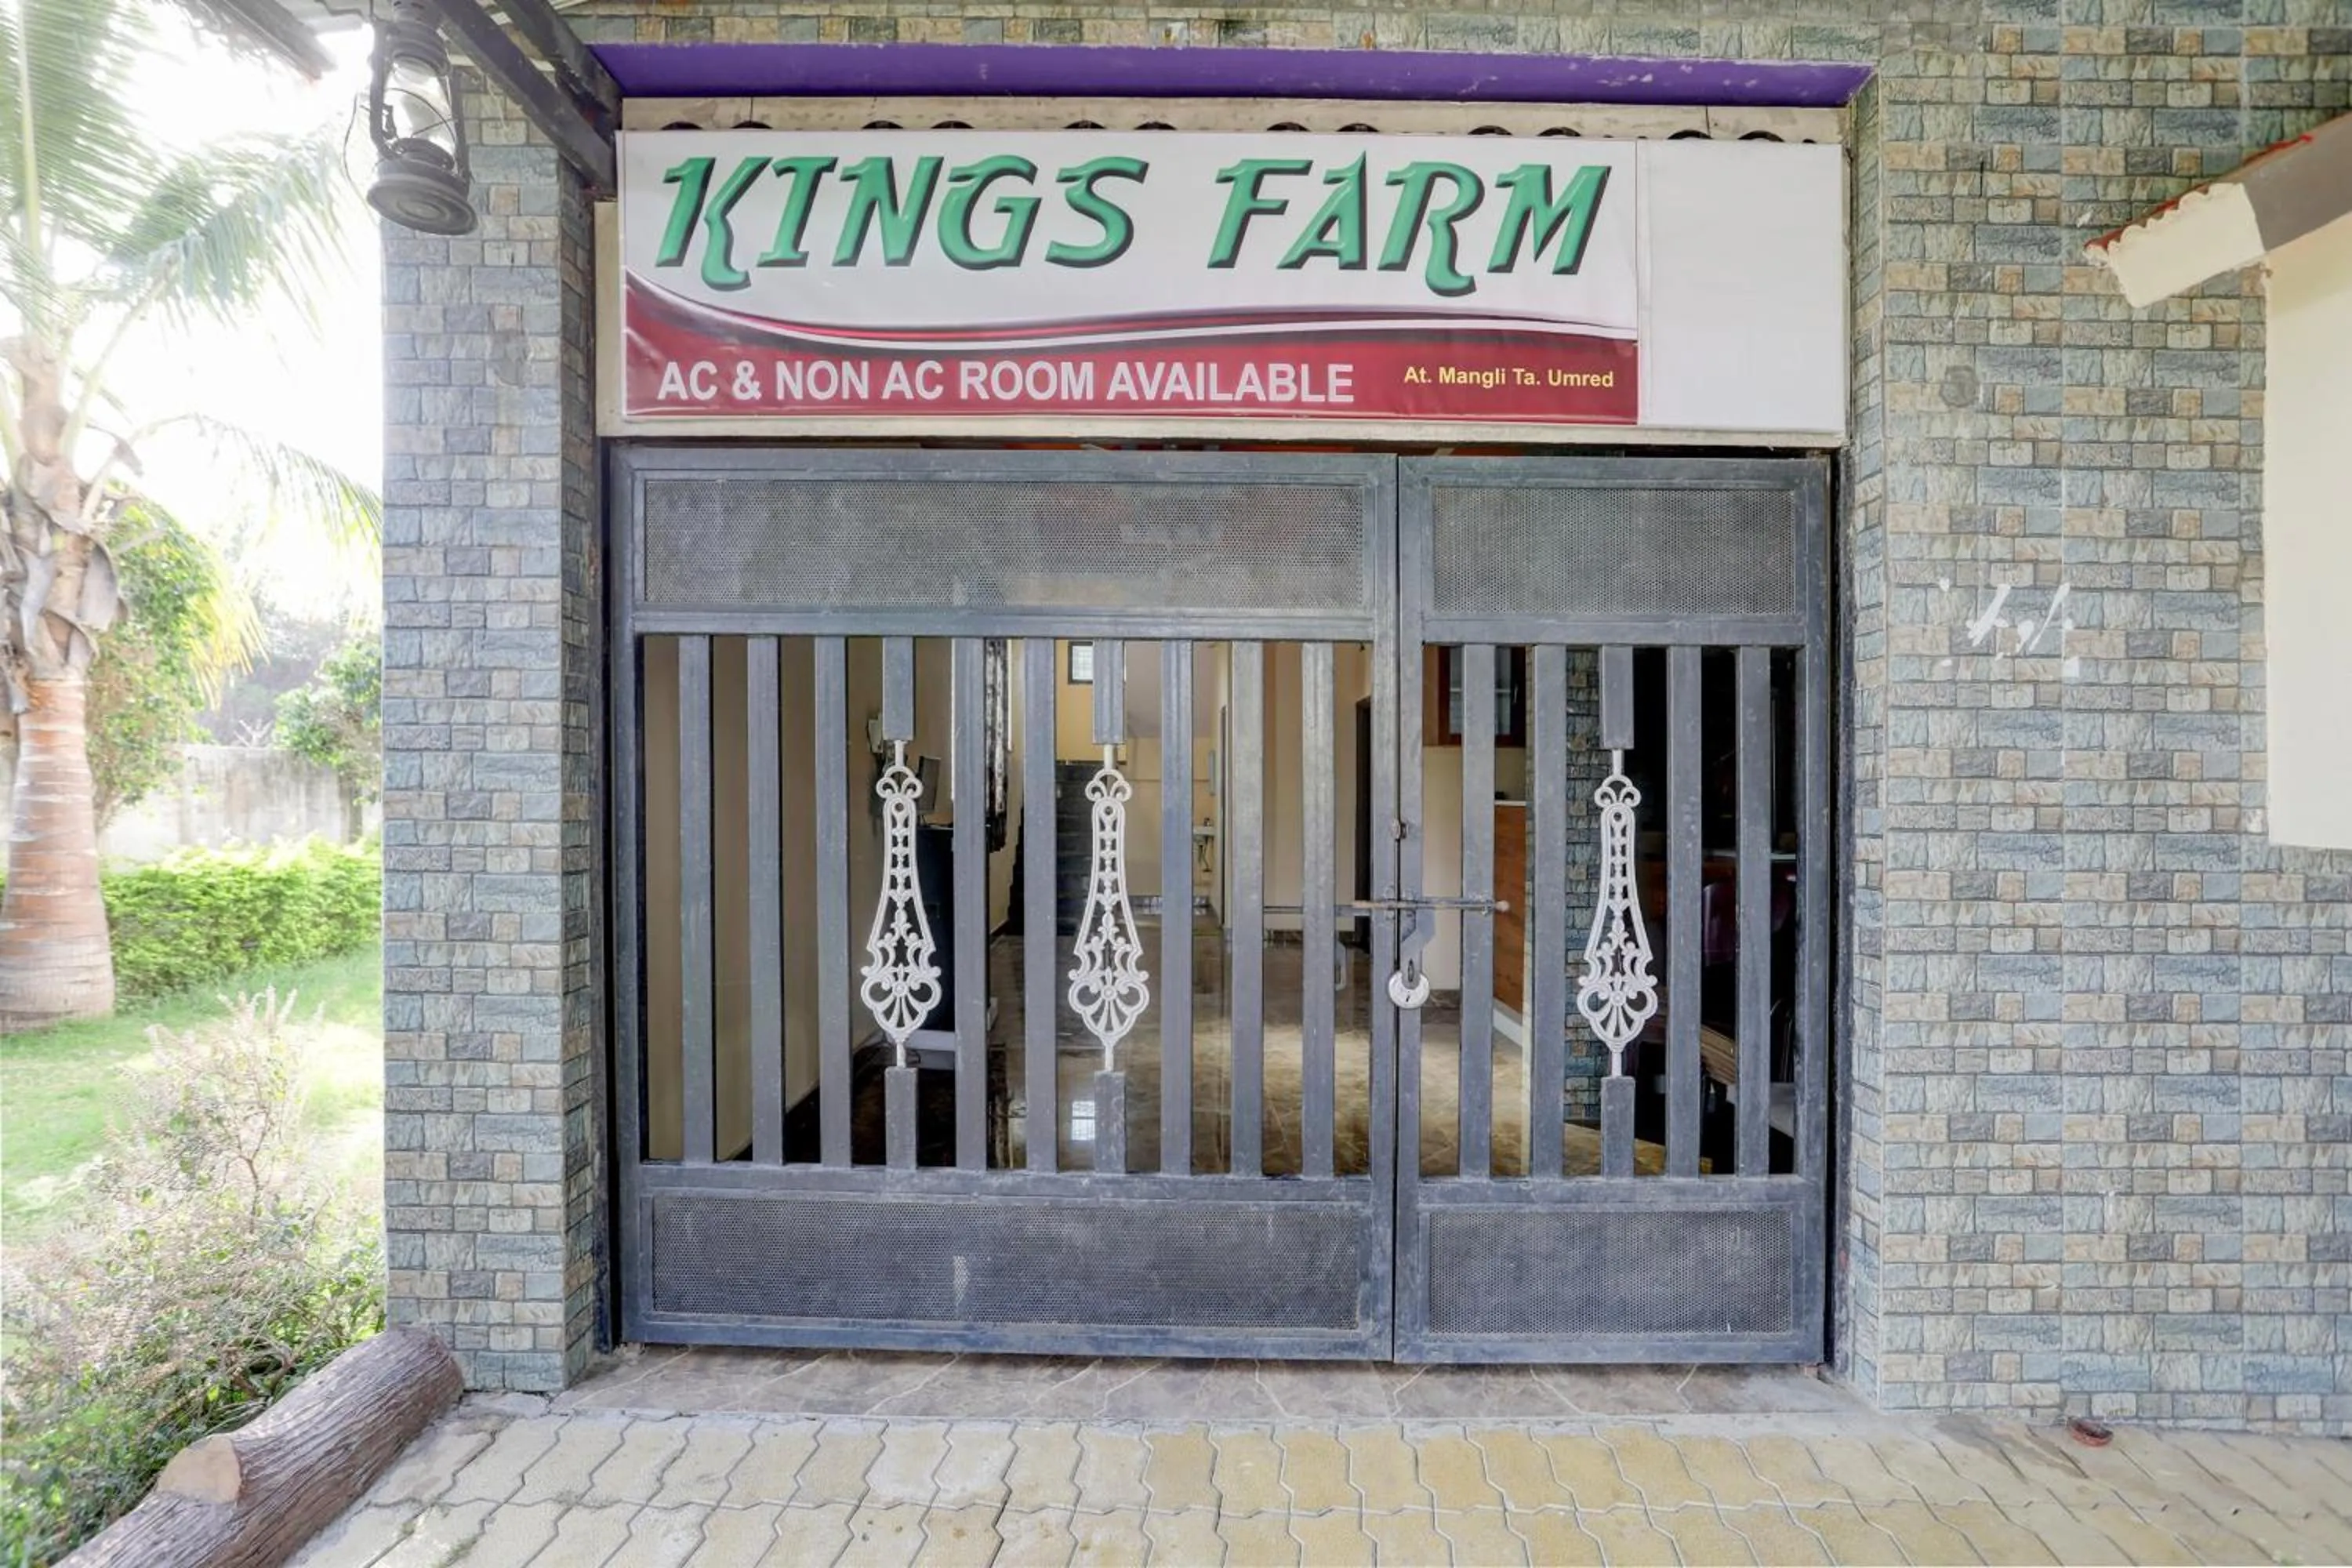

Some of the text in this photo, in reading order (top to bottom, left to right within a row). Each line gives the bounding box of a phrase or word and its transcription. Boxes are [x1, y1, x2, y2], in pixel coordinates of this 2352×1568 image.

[655, 150, 1612, 296] KINGS FARM
[657, 361, 1356, 403] AC & NON AC ROOM AVAILABLE
[1403, 366, 1614, 388] At. Mangli Ta. Umred
